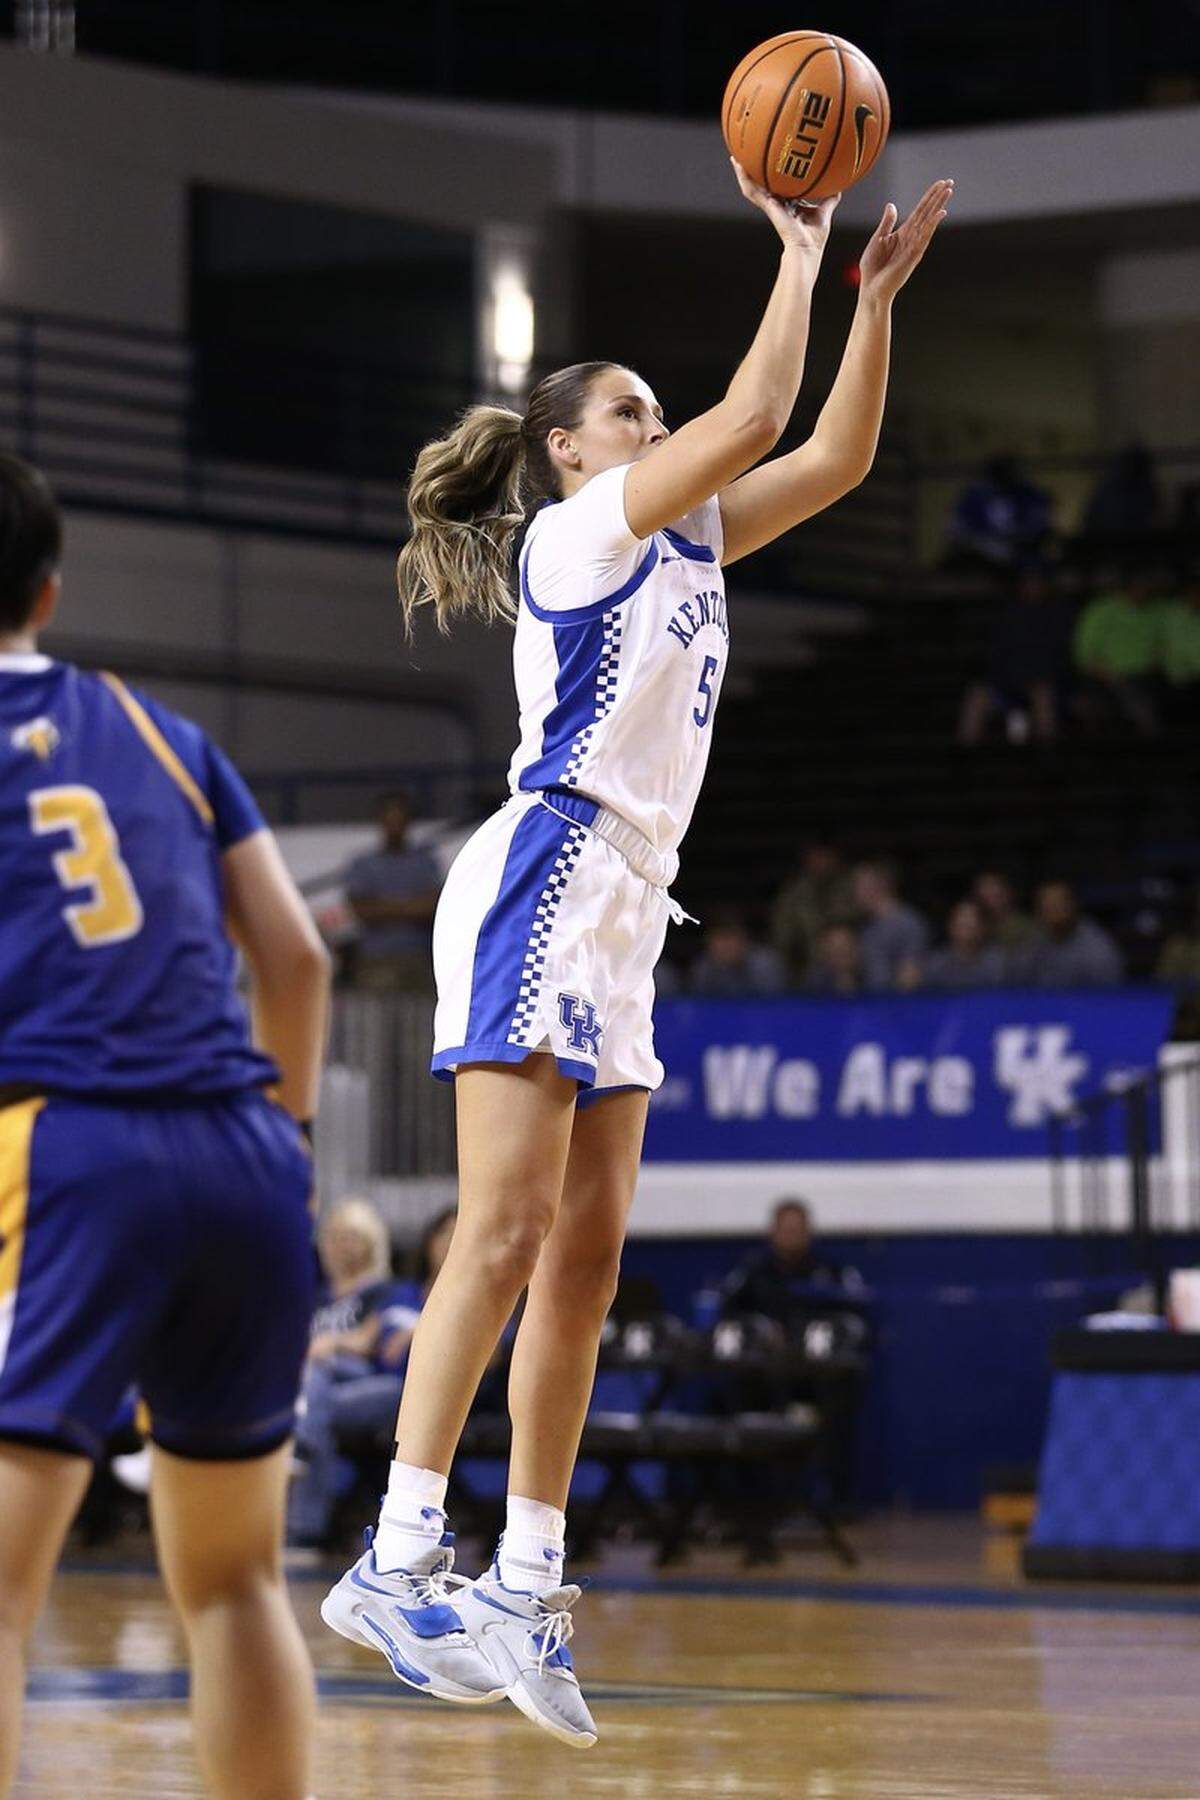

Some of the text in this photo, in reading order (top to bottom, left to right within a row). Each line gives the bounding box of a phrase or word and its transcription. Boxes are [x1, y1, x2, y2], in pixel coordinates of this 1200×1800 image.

[782, 92, 832, 179] ELITE
[667, 591, 729, 649] KENTU
[693, 655, 718, 728] 5
[28, 784, 144, 947] 3
[558, 992, 603, 1059] UK
[704, 1045, 819, 1119] We
[838, 1042, 974, 1118] Are
